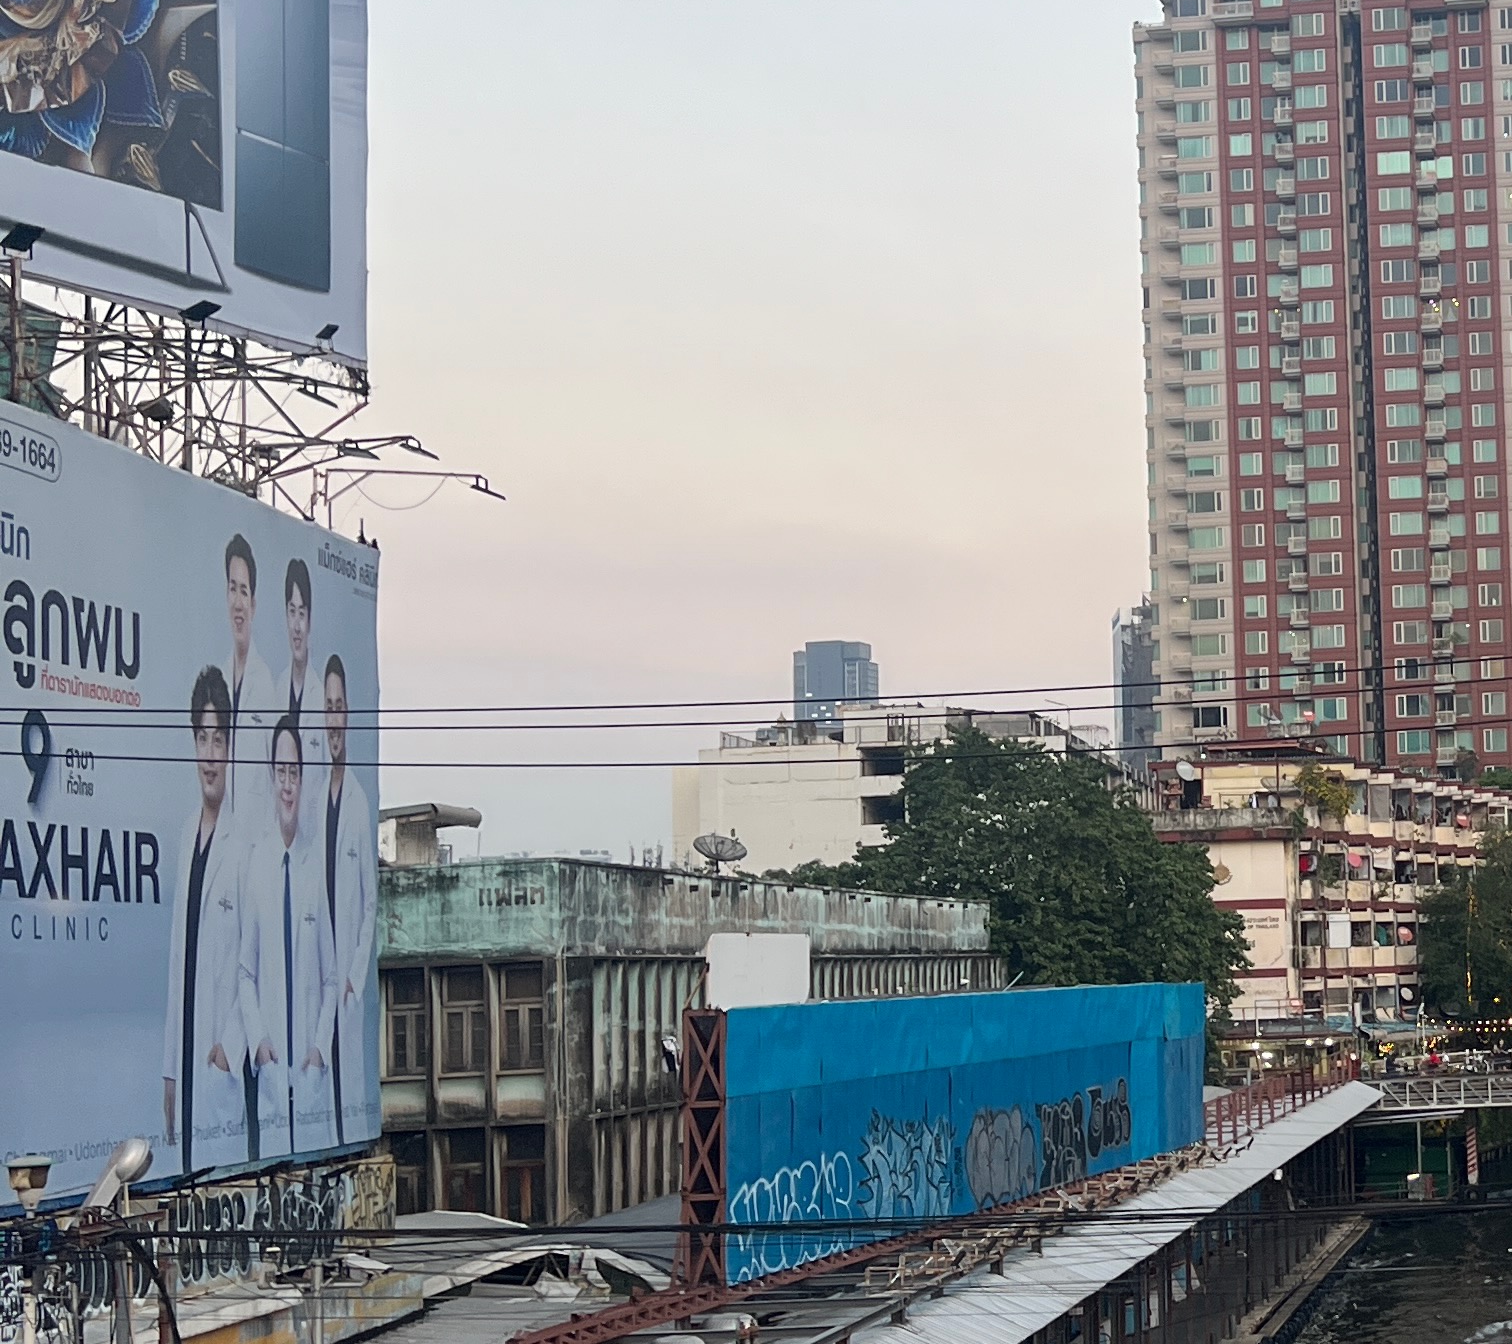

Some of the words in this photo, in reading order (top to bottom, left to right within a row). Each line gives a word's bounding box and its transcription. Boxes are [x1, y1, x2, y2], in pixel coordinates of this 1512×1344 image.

[0, 429, 56, 474] 9-1664
[3, 579, 141, 689] ลูกผม
[21, 708, 51, 804] 9
[65, 747, 95, 771] สาขา
[11, 913, 109, 941] CLINIC
